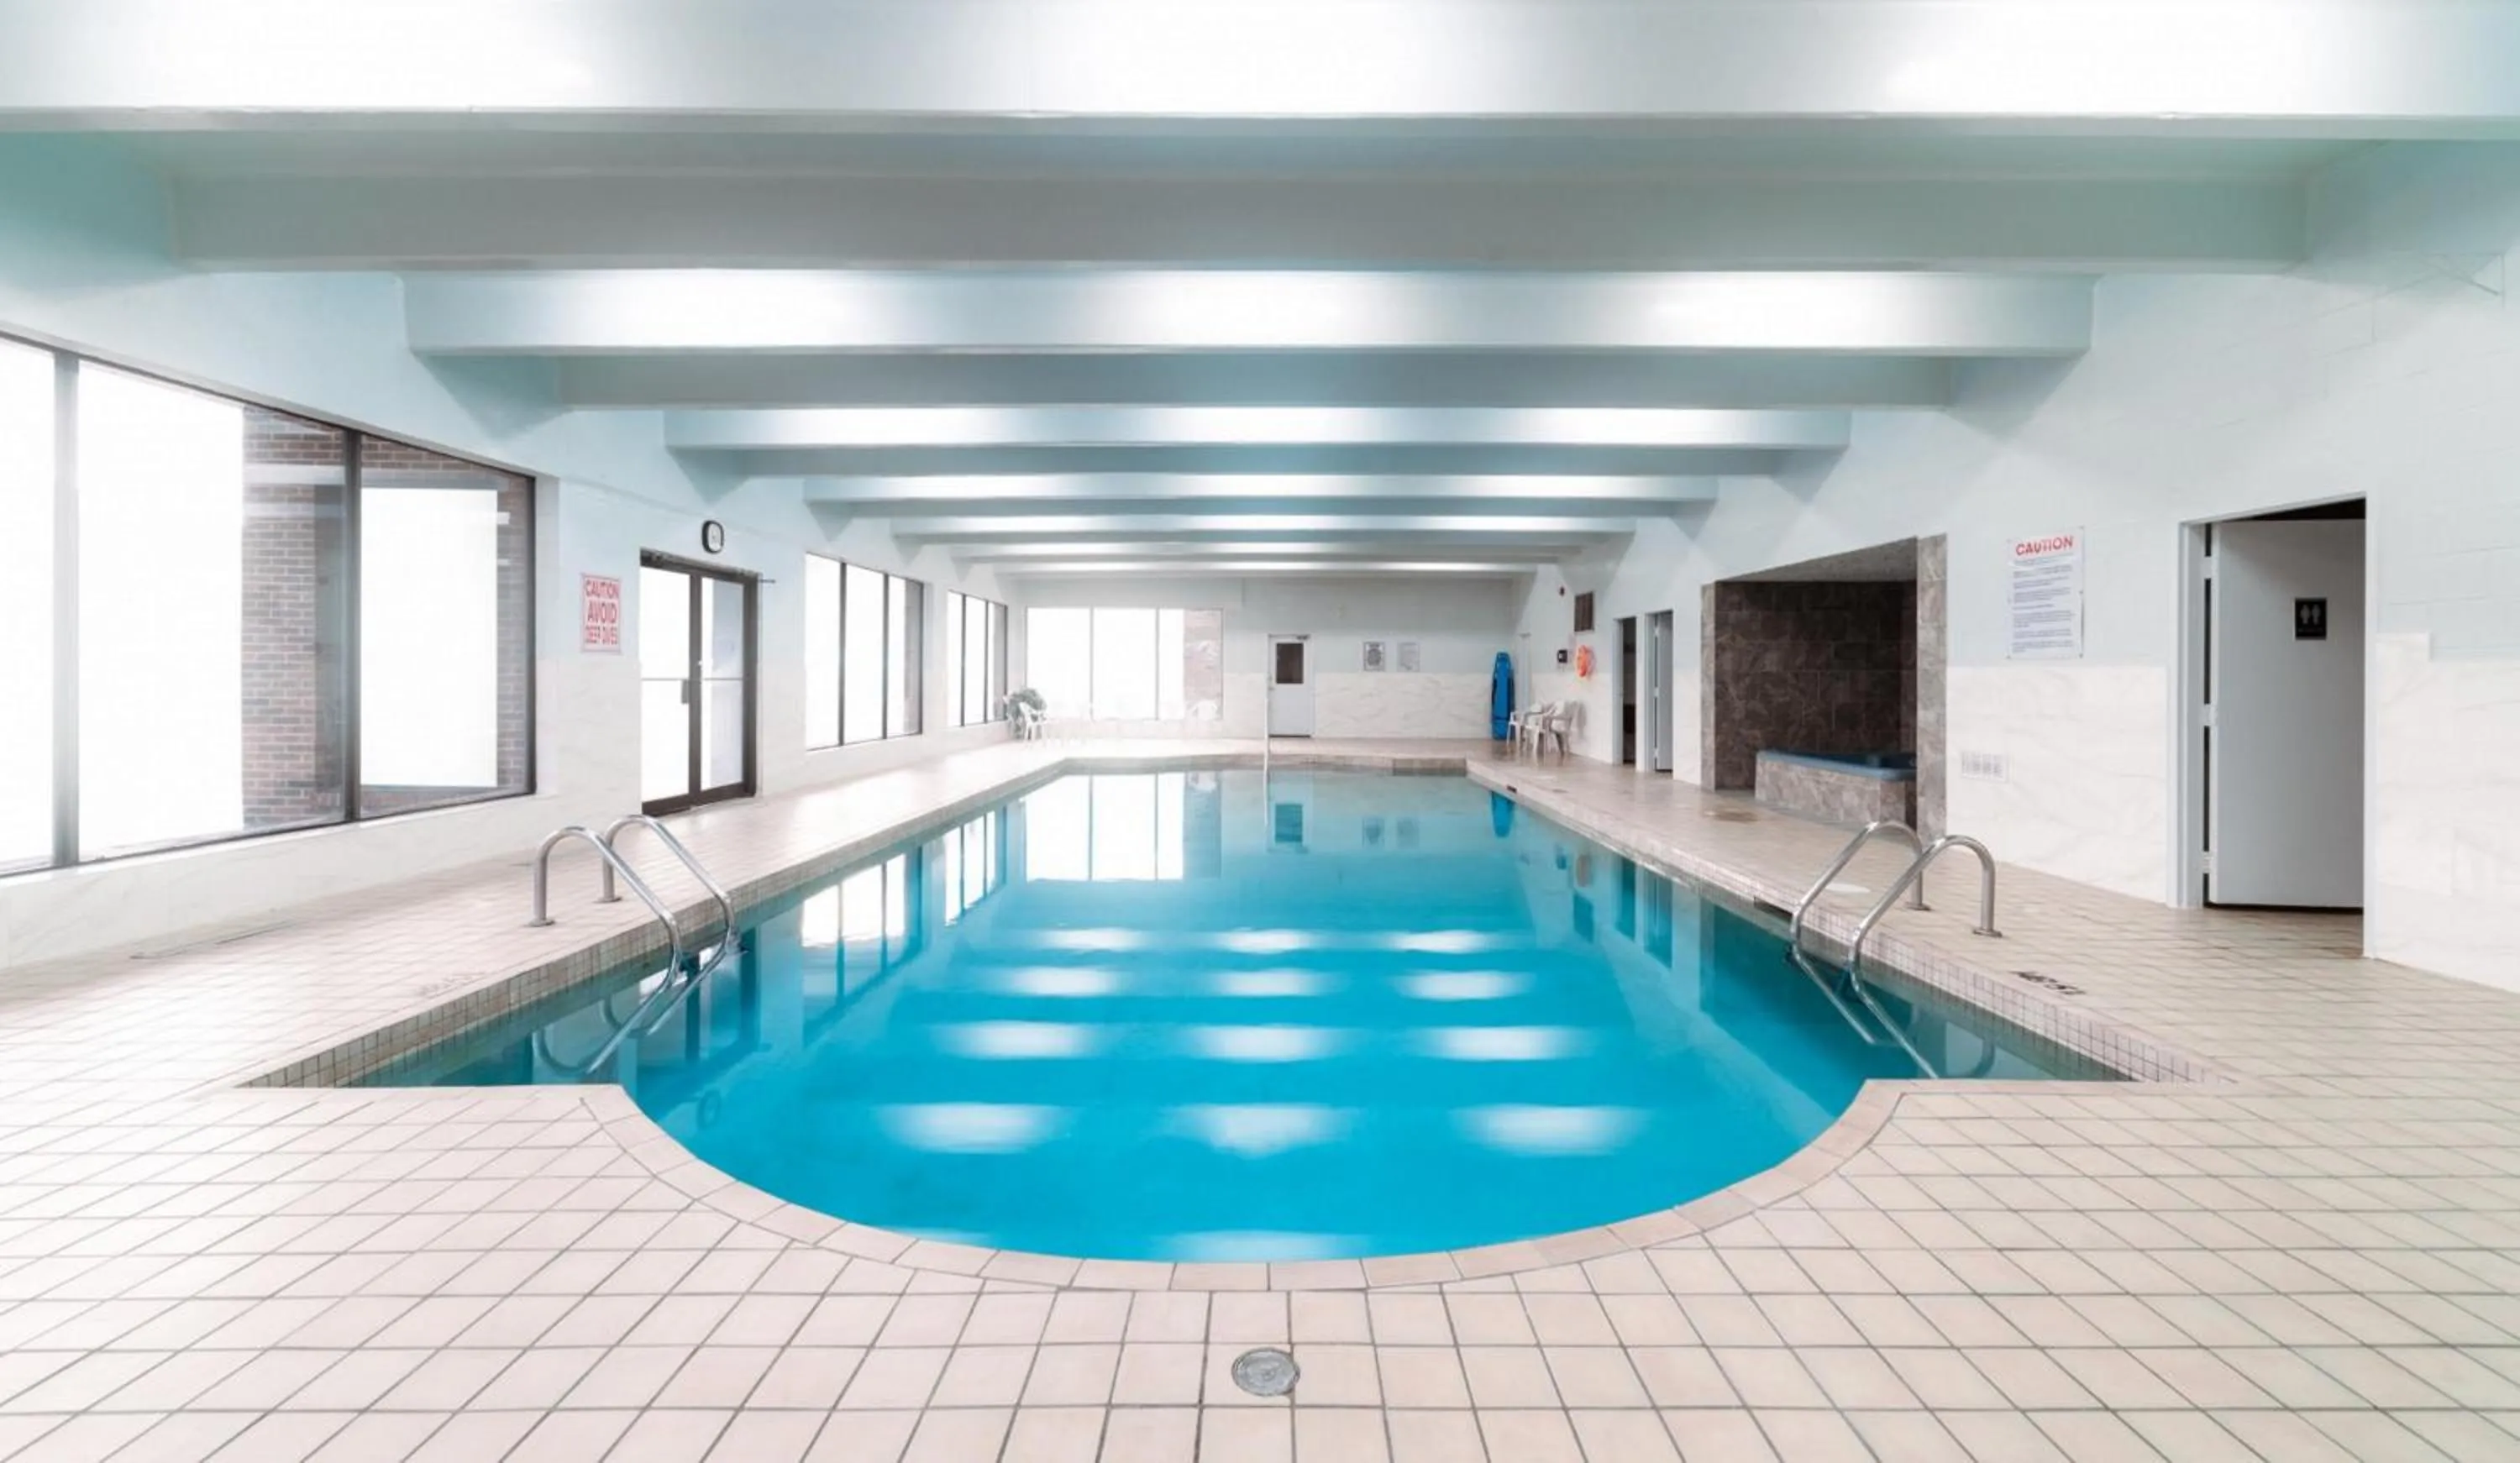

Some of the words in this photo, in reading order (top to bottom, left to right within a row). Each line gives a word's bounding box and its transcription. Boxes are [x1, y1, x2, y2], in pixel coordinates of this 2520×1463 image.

[2015, 536, 2073, 555] CAUTION
[585, 579, 619, 599] CAUTION
[587, 601, 617, 623] AVOID
